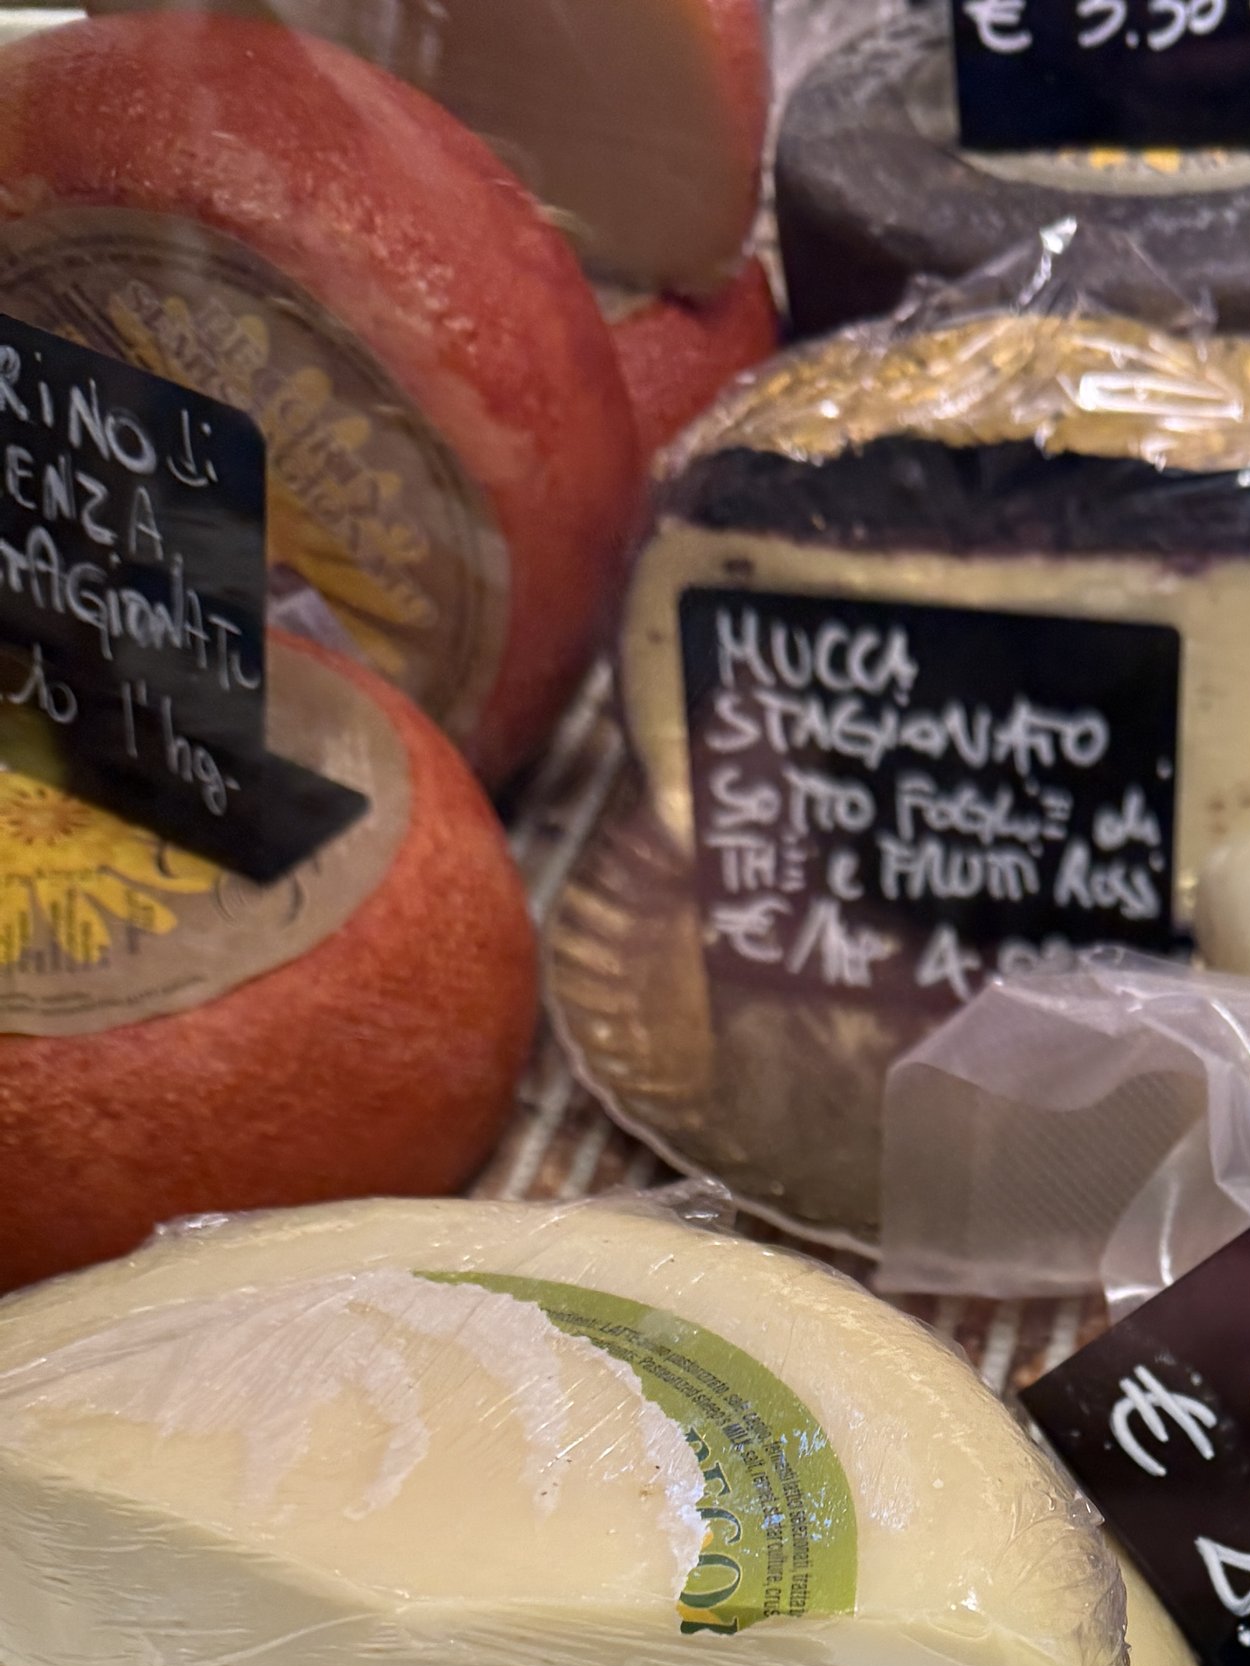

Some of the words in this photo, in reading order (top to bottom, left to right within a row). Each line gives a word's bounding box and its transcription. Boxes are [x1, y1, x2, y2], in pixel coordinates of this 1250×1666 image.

[714, 604, 920, 705] MUCCA
[711, 764, 877, 835] SOTTO
[1107, 1365, 1217, 1477] €
